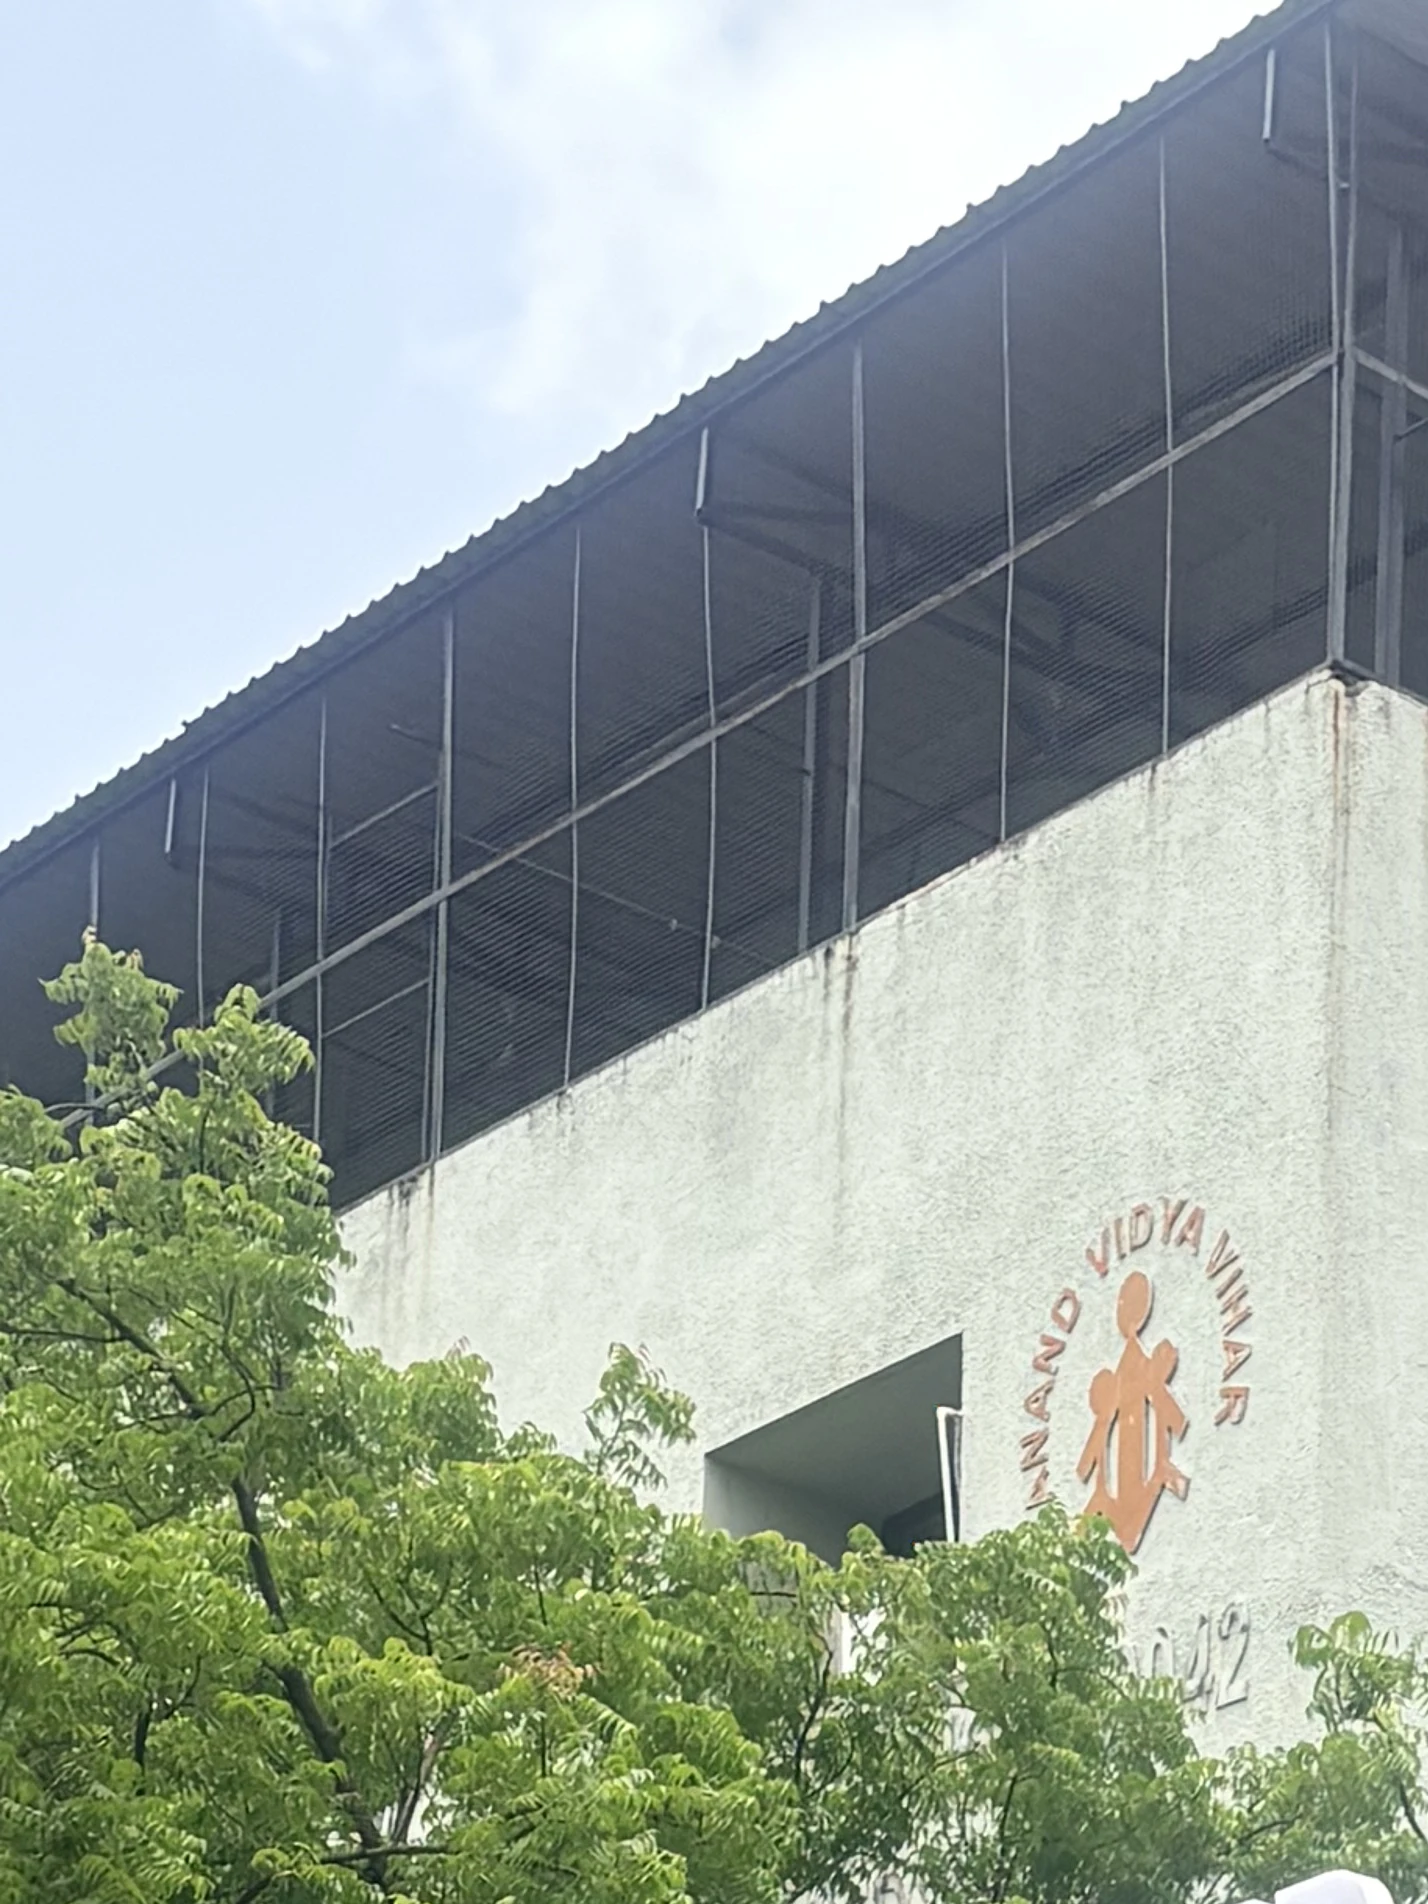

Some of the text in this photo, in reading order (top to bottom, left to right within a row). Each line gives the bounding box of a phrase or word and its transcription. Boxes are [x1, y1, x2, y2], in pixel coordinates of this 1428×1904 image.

[1018, 1195, 1253, 1510] ANAND VIDYA VIHAR
